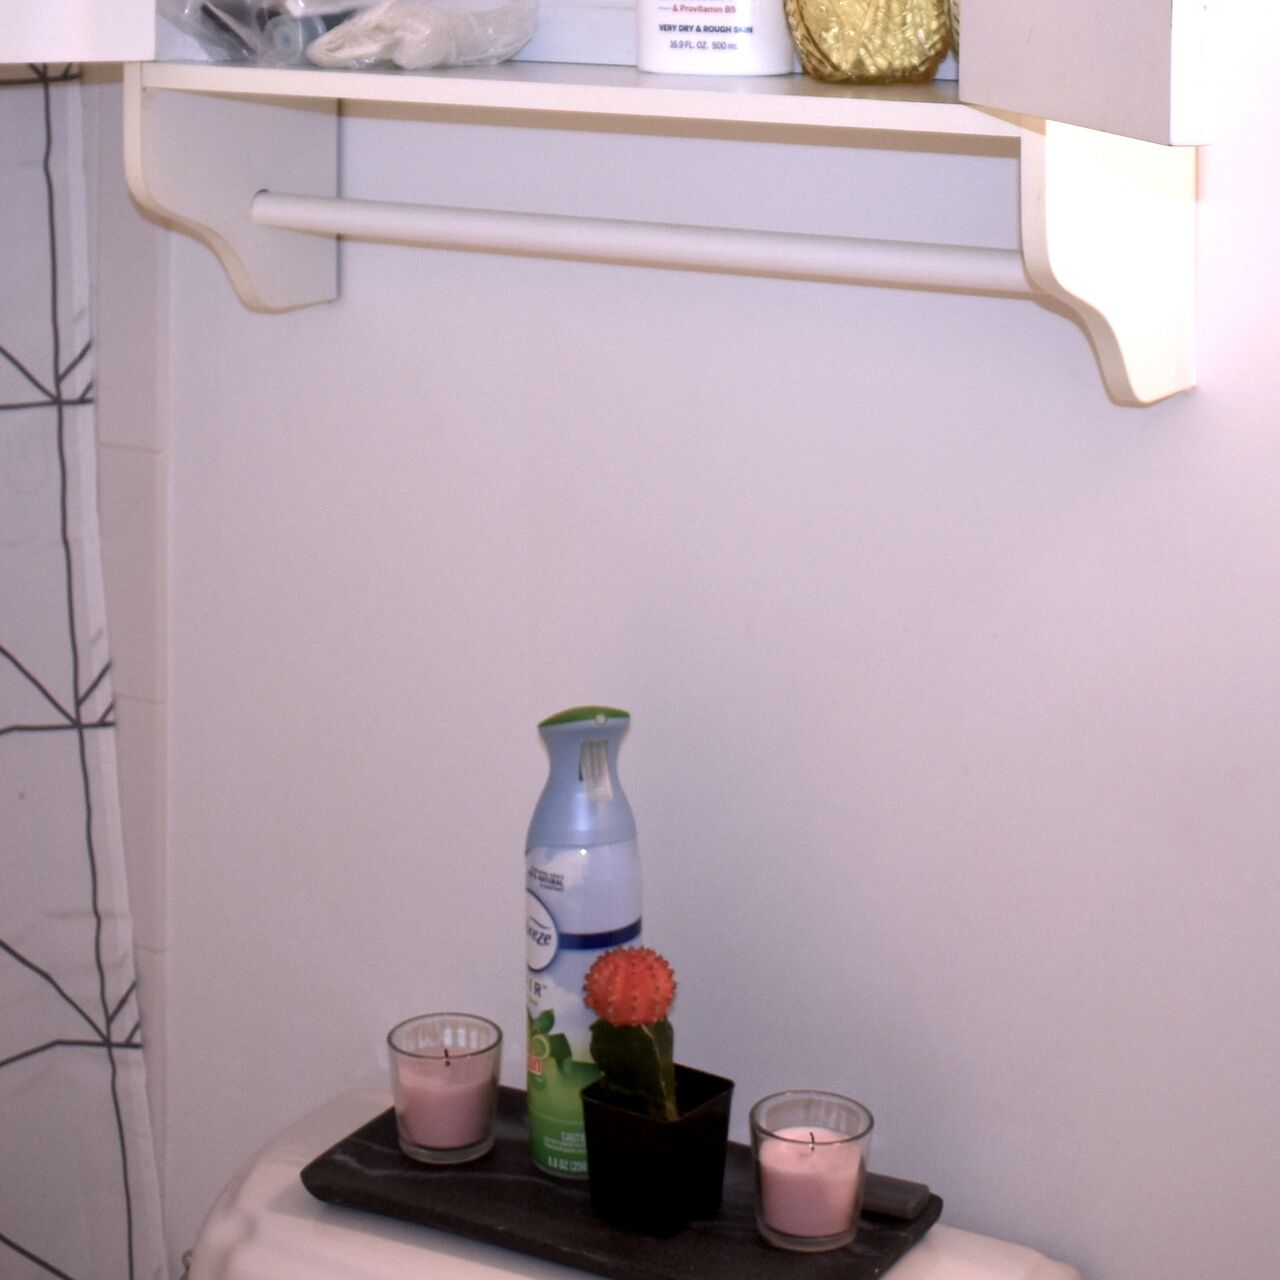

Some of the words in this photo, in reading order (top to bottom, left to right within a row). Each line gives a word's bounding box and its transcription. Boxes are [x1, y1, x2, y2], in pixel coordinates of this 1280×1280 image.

[672, 3, 678, 12] &
[679, 4, 723, 13] Provitamin
[658, 23, 677, 32] VERY
[678, 24, 694, 32] DRY
[695, 25, 702, 33] &
[703, 25, 732, 33] ROUGH
[669, 40, 684, 49] 16.9
[711, 41, 727, 50] 500
[527, 926, 552, 947] reze
